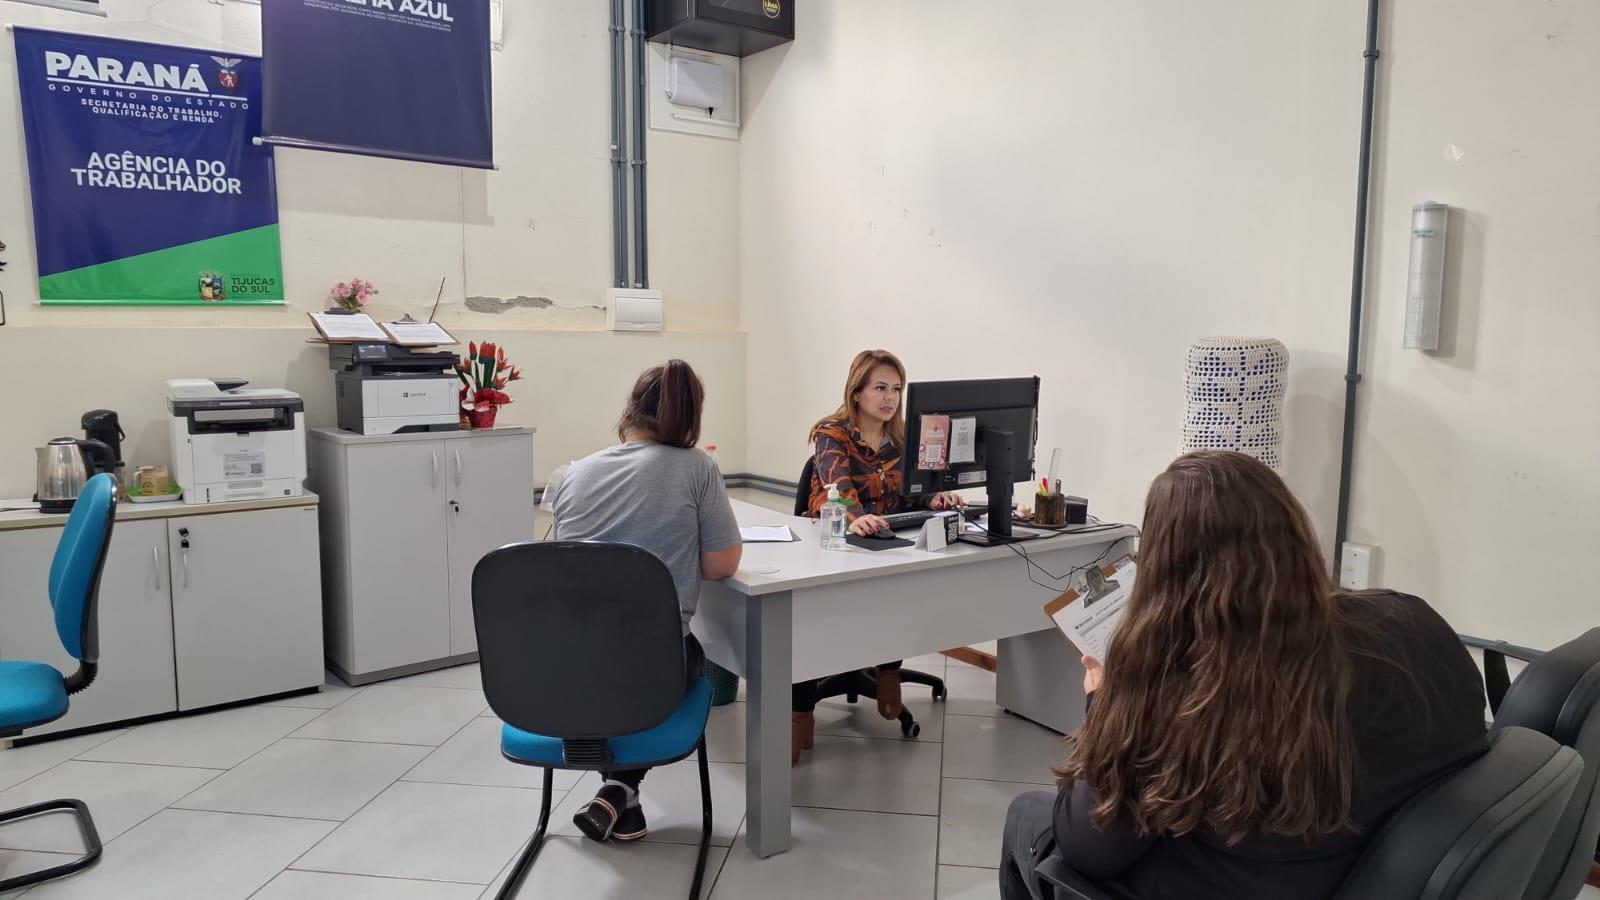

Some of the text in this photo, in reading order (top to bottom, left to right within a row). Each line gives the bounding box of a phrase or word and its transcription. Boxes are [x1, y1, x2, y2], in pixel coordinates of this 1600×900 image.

[398, 0, 455, 22] AZUL
[45, 50, 209, 92] PARANÁ
[48, 83, 249, 110] GOVERNO DO ESTADO
[81, 98, 147, 111] SECRETARIA
[150, 105, 164, 113] DO
[92, 106, 169, 120] QUALIFICAÇÃO
[182, 114, 215, 124] RENDA
[87, 151, 226, 176] AGÊNCIA DO
[70, 168, 242, 194] TRABALHADOR
[231, 277, 275, 286] TIJUCAS
[232, 285, 271, 293] DO SUL
